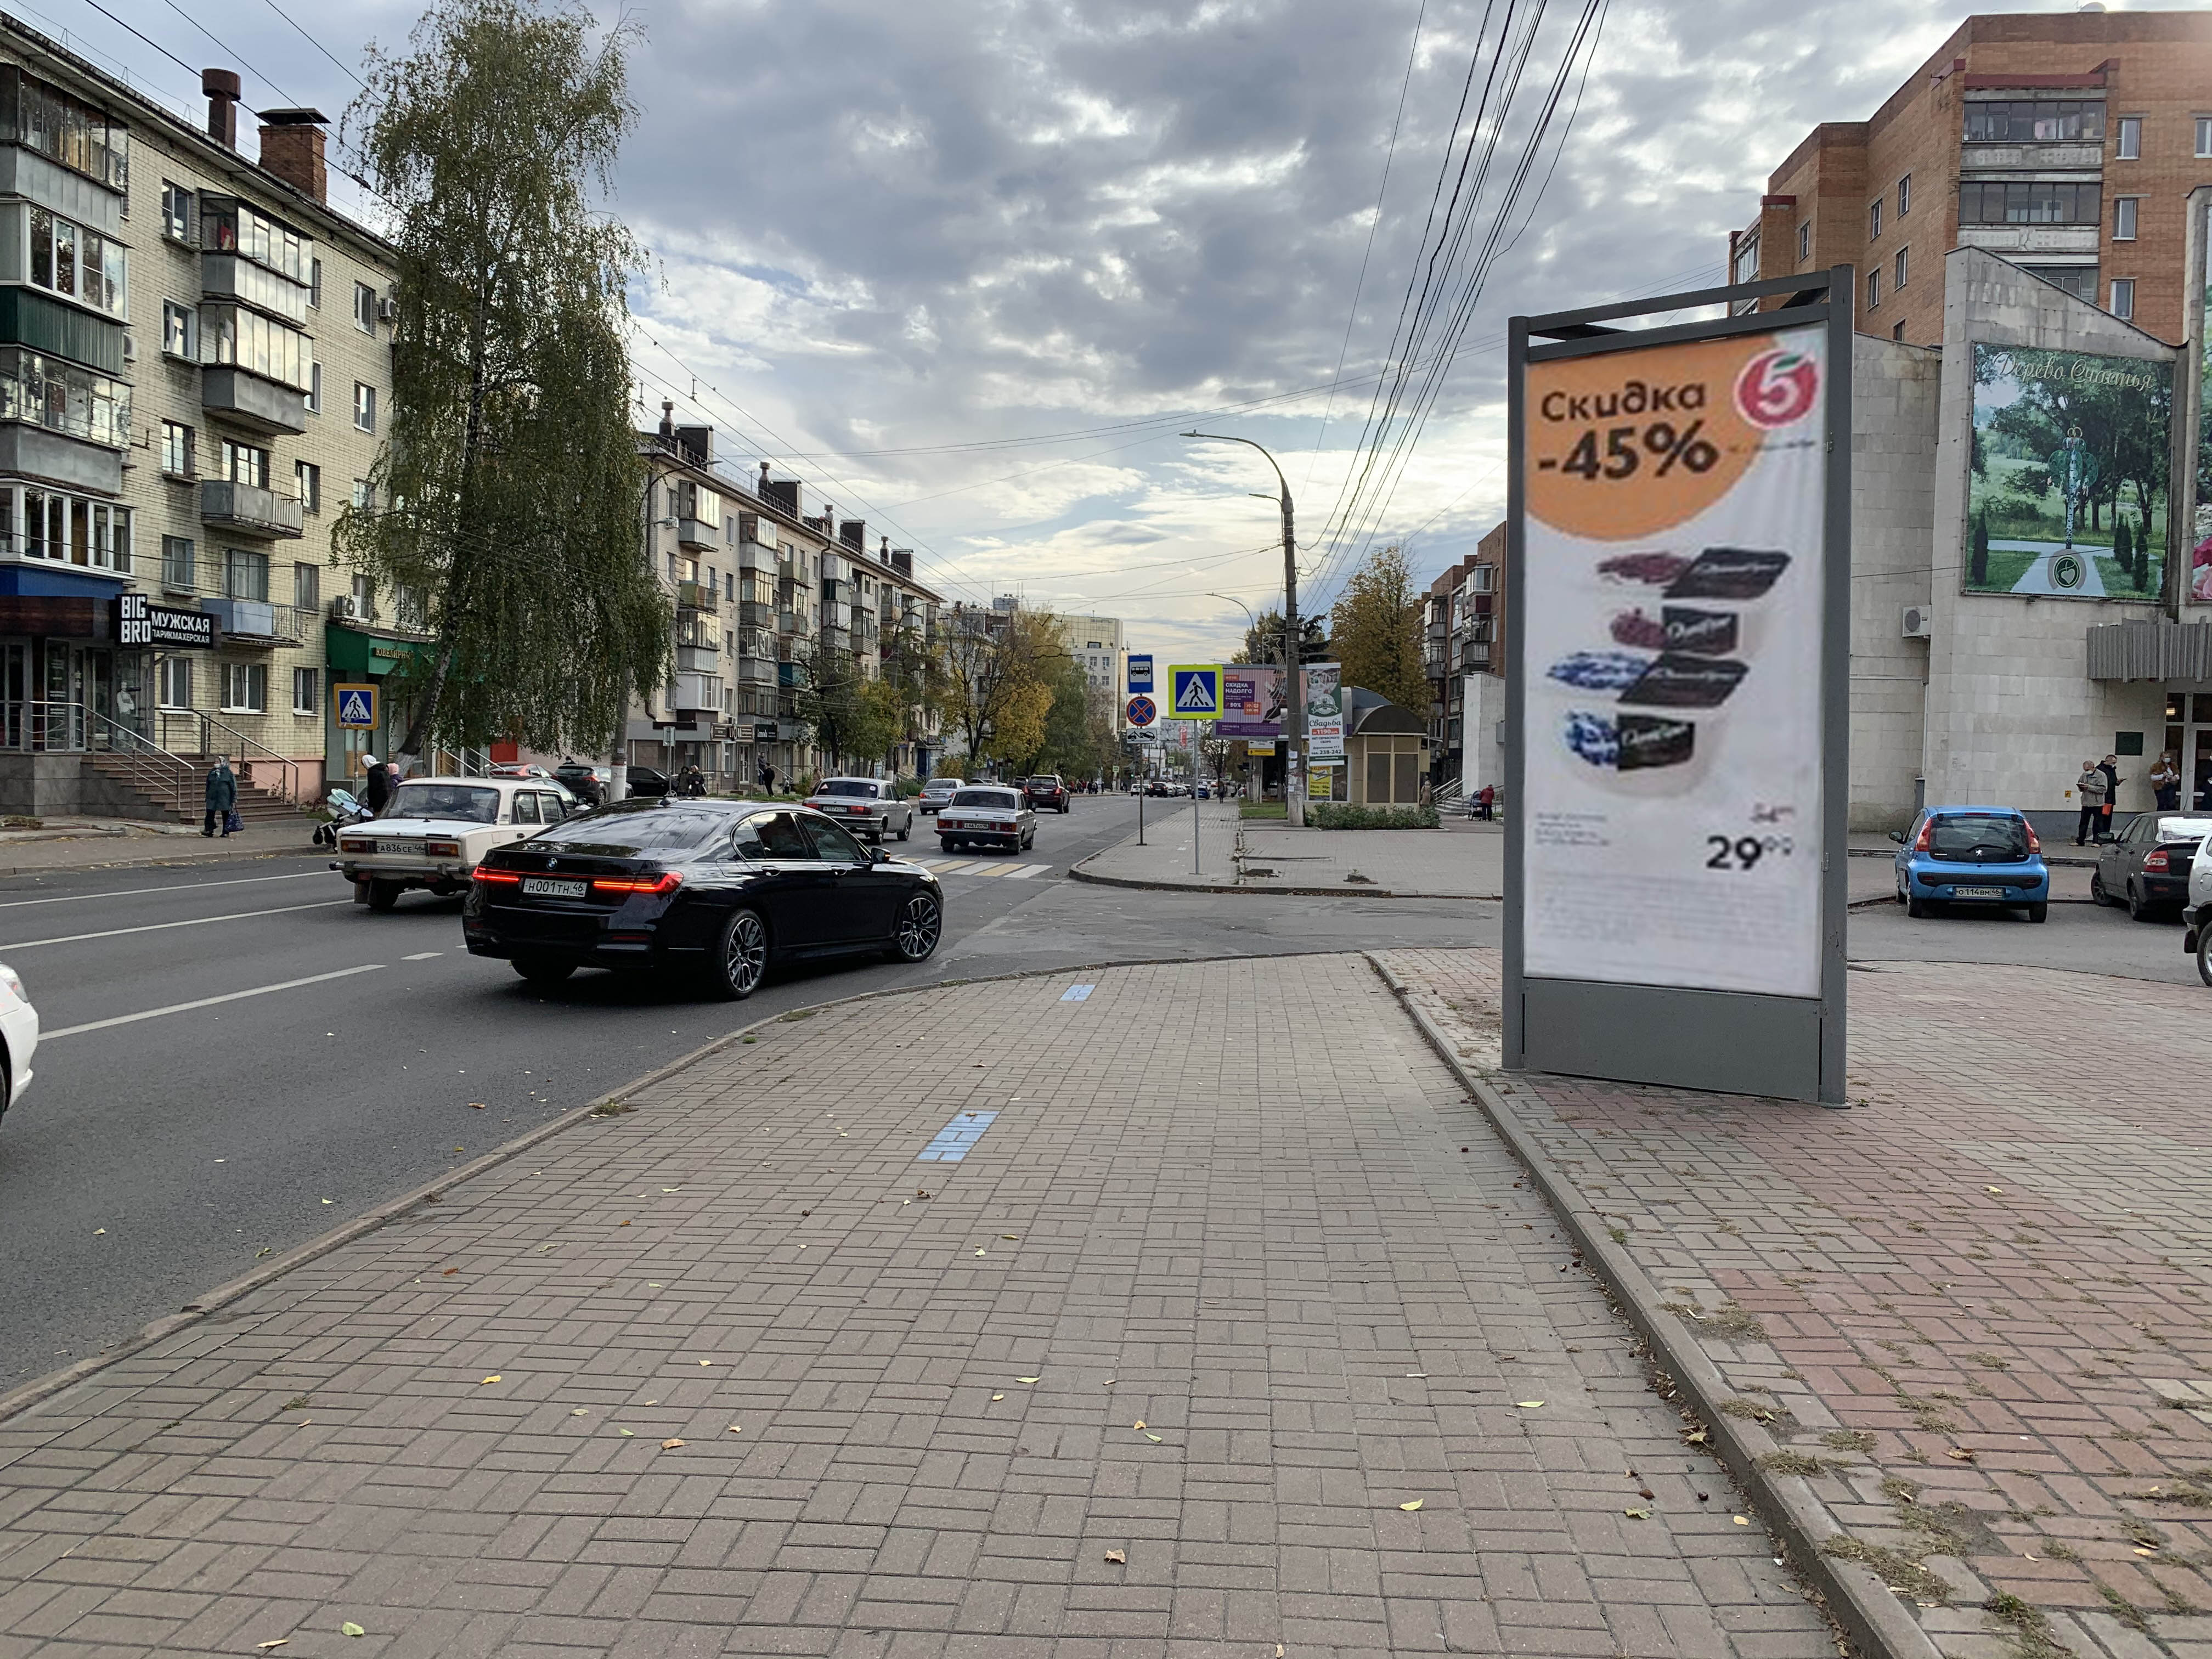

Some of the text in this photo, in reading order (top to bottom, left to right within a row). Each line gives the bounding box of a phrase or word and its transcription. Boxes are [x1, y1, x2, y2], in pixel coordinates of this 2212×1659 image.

[1993, 352, 2155, 391] Дерево Счастья
[1541, 380, 1706, 422] Скидка
[1538, 419, 1720, 481] -45%
[121, 596, 146, 618] BIG
[121, 620, 151, 643] BRO
[151, 611, 210, 633] МУЖСКАЯ
[1309, 718, 1341, 728] Свадьба
[380, 844, 412, 853] А836СЕ
[1706, 834, 1763, 871] 29
[528, 881, 583, 894] Н001ТН 46
